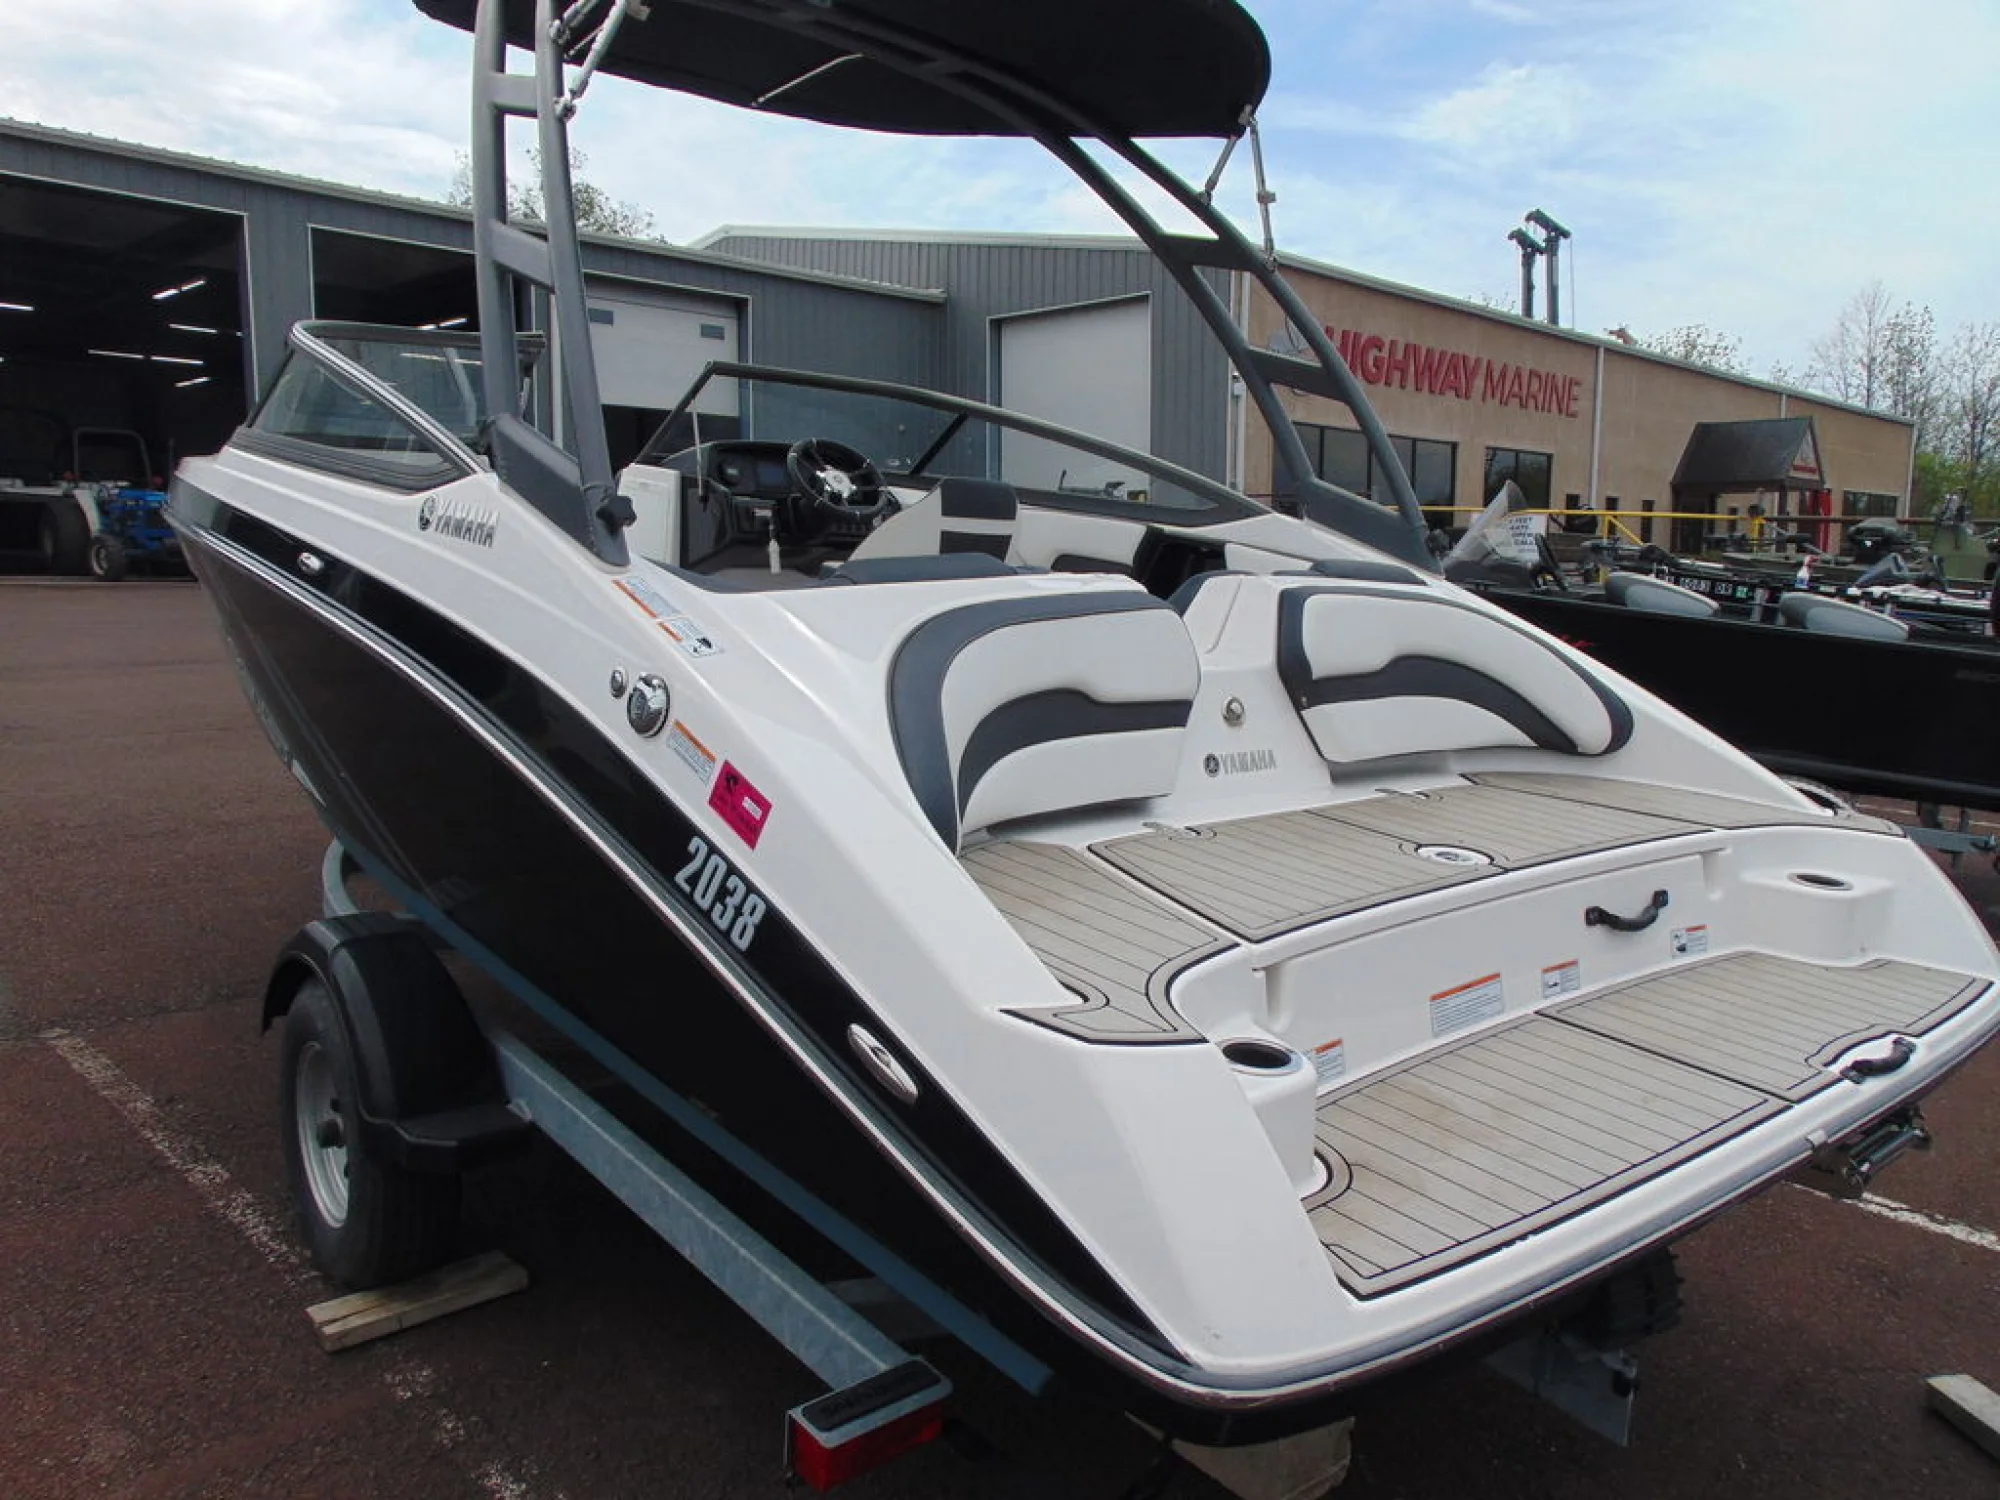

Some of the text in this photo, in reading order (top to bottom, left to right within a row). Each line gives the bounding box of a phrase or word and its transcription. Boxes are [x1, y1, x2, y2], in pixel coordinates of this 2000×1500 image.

[1481, 358, 1583, 419] MARINE
[434, 498, 501, 548] YAMAHA
[1218, 749, 1277, 775] YAMAHA
[673, 835, 767, 952] 2038
